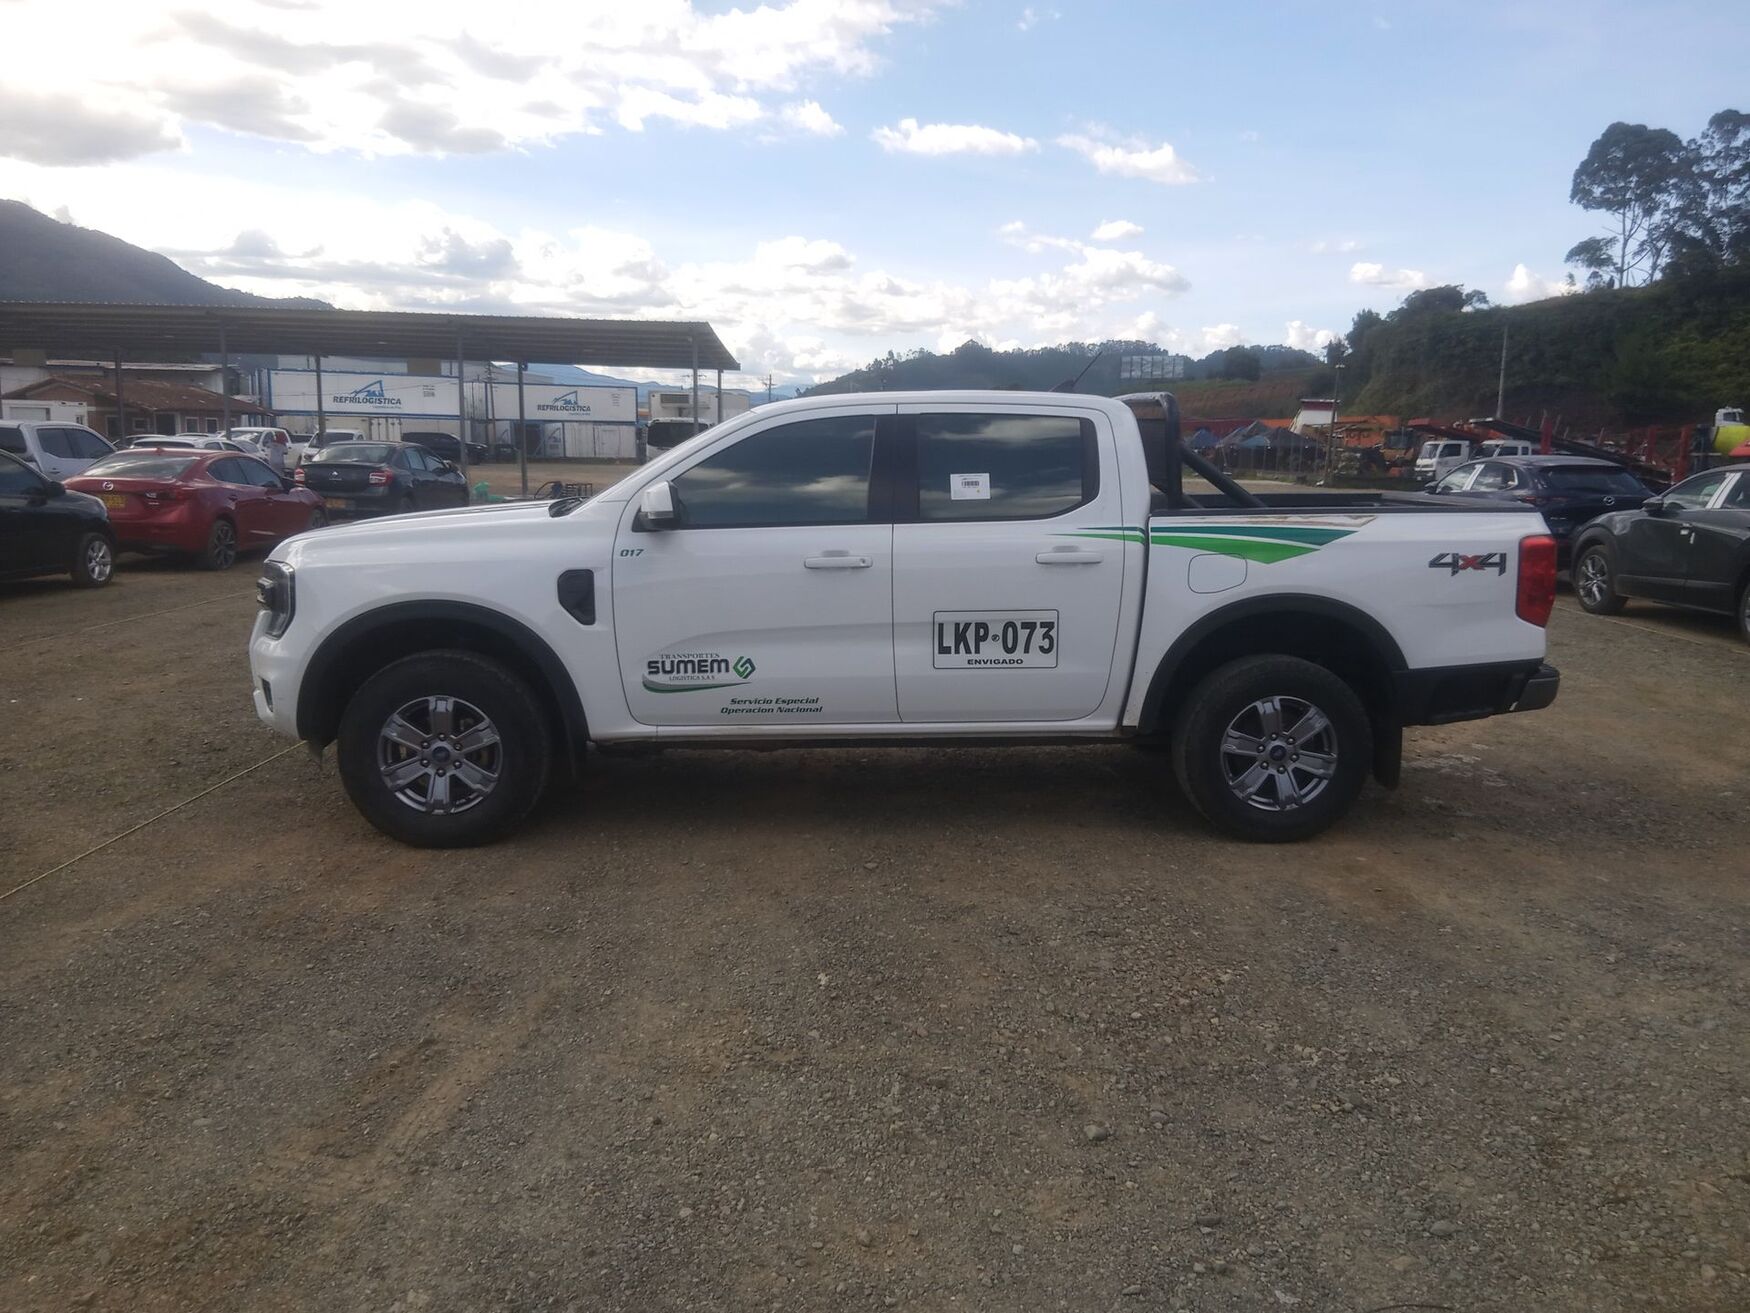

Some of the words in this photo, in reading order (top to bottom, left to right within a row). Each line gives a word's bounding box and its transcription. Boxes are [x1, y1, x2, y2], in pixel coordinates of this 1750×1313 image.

[620, 549, 644, 557] 017
[967, 658, 1024, 666] ENVIGADO
[730, 697, 773, 705] Servicio
[775, 697, 820, 705] Especial
[776, 706, 824, 714] Nacional
